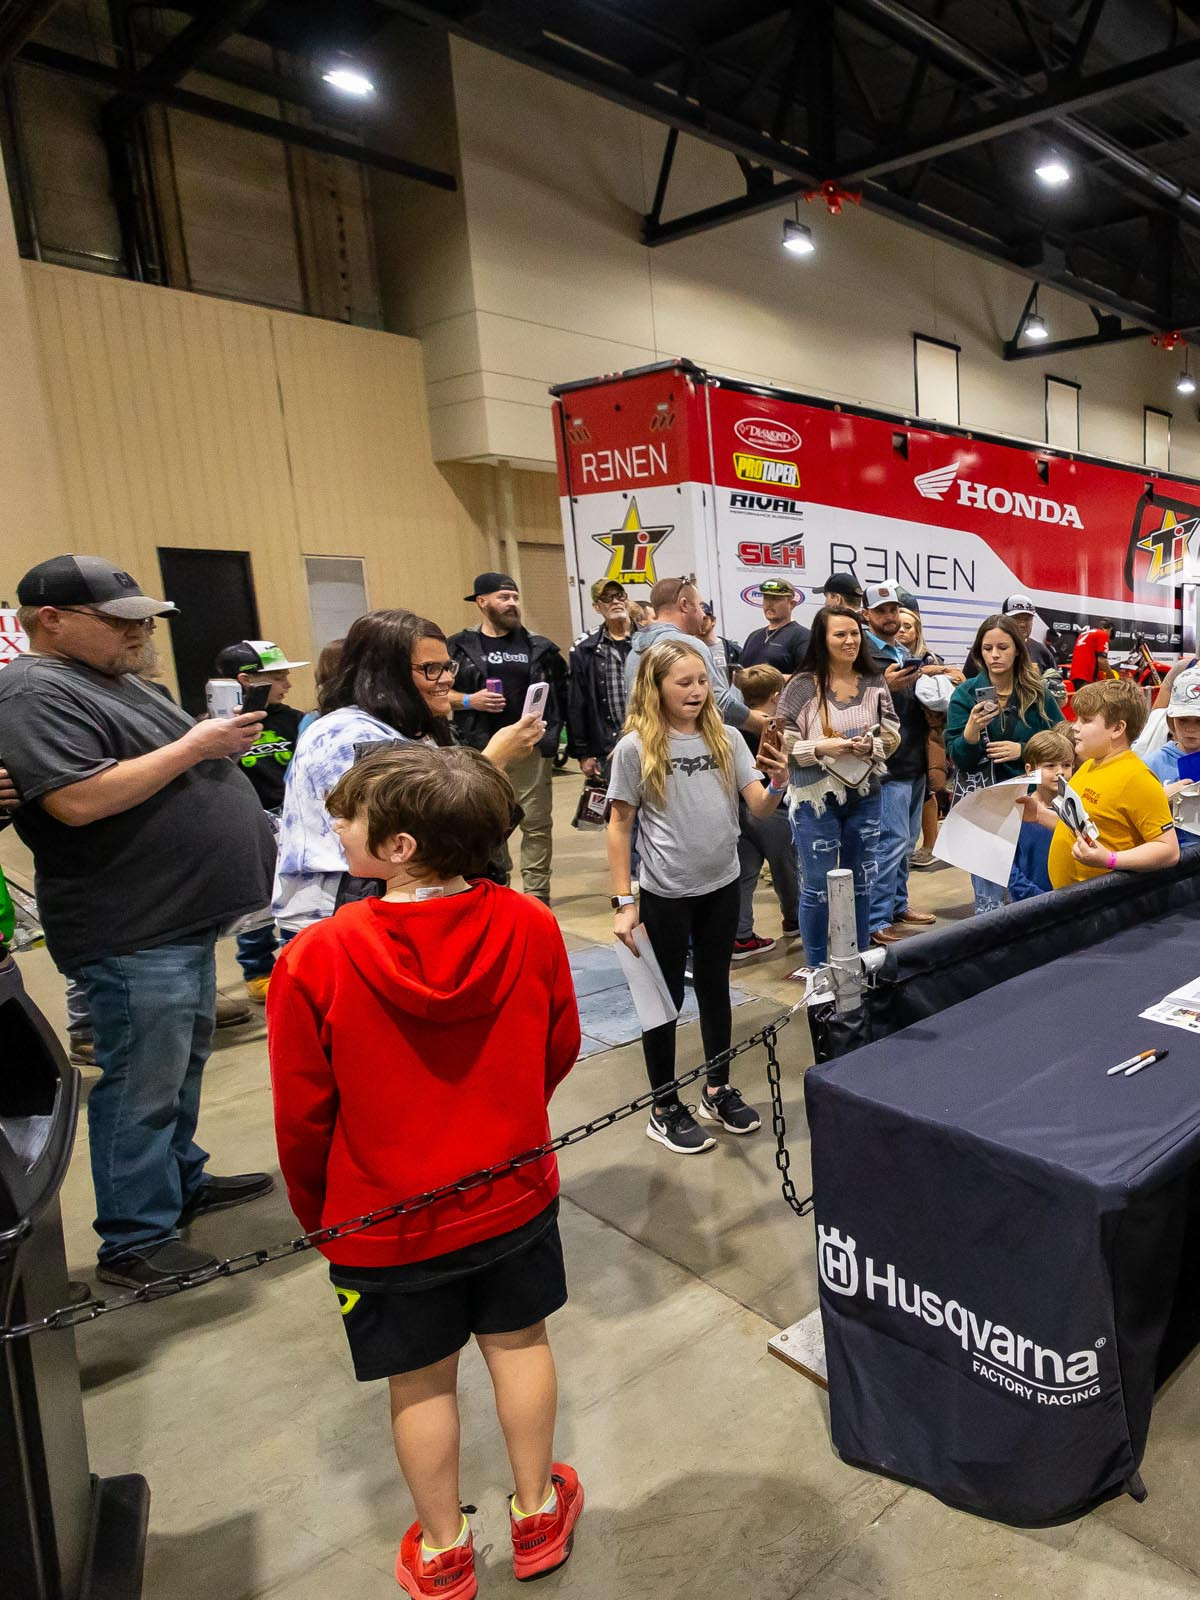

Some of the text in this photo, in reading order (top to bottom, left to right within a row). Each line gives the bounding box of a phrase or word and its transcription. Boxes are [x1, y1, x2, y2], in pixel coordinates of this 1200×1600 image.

[737, 456, 797, 486] PROTAPER
[730, 493, 803, 515] RIVAL
[957, 479, 1084, 530] HONDA
[737, 541, 806, 569] SLH
[866, 1257, 1100, 1383] Husqvarna
[973, 1360, 1101, 1406] FACTORY RACING
